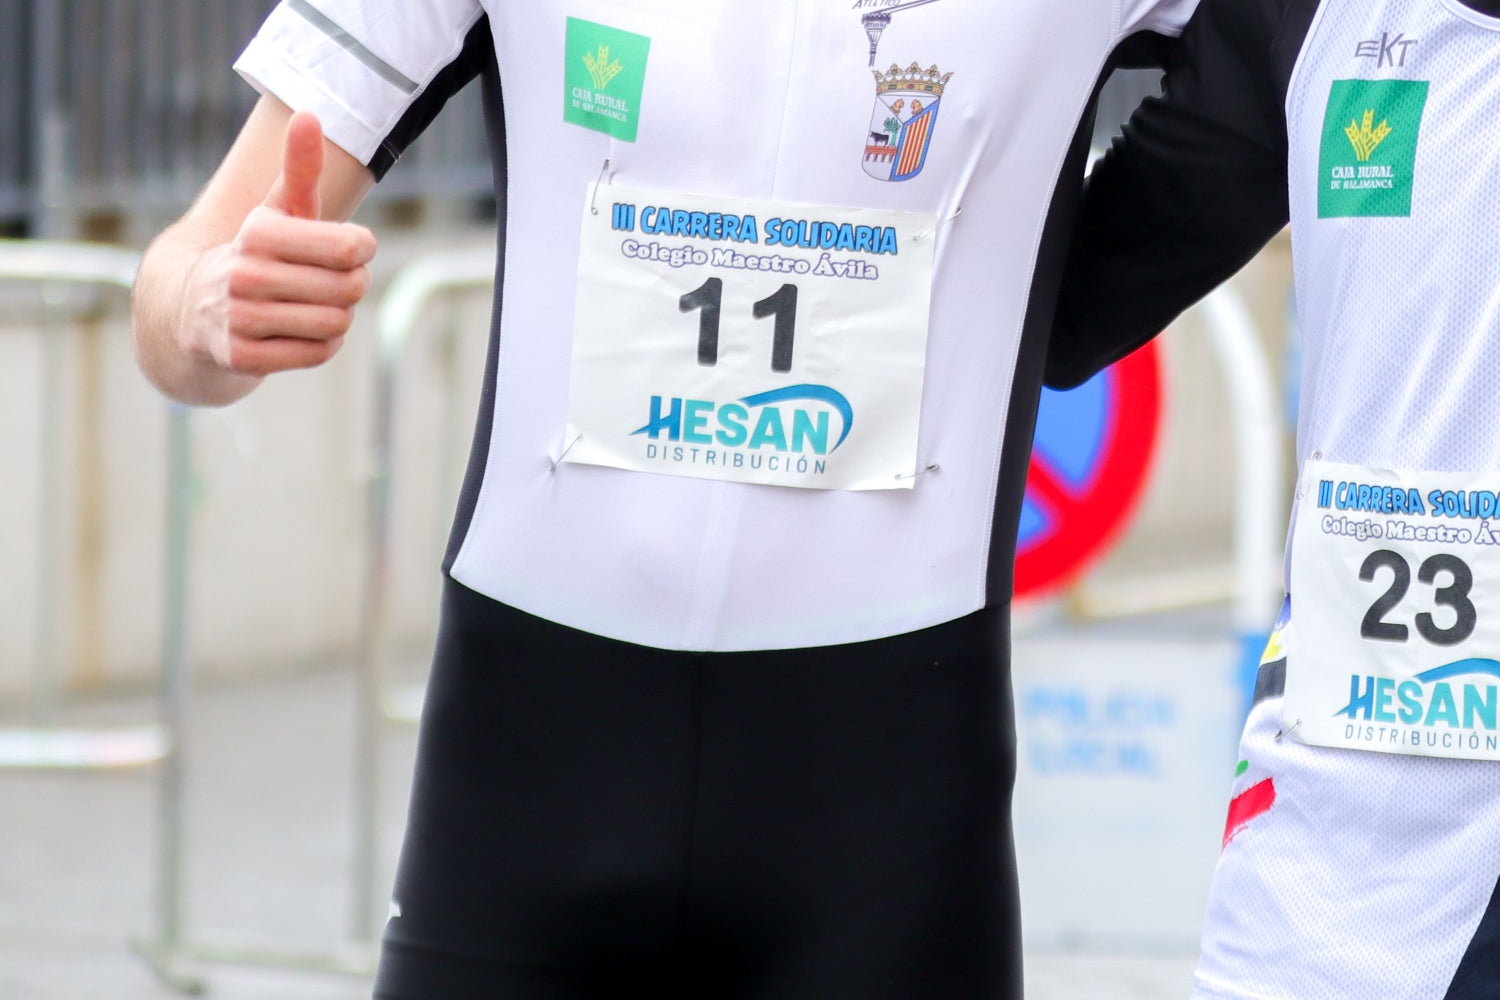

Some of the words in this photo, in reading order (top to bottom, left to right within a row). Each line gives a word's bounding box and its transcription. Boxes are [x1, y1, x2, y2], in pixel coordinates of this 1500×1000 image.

[594, 93, 629, 112] RURAL
[1330, 180, 1341, 189] DE
[1343, 179, 1393, 189] SALAMANCA
[1331, 166, 1355, 179] CAJA
[1357, 165, 1394, 178] RURAL
[612, 203, 635, 231] III
[640, 206, 758, 243] CARRERA
[764, 218, 898, 255] SOLIDARIA
[621, 240, 708, 268] Colegio
[712, 249, 810, 275] Maestro
[813, 254, 878, 280] Ávila
[679, 277, 798, 374] 11
[633, 395, 830, 456] HESAN
[647, 444, 826, 474] DISTRIBUCIÓN
[1317, 480, 1333, 508] III
[1336, 482, 1425, 515] CARRERA
[1321, 515, 1383, 541] Colegio
[1386, 521, 1472, 544] Maestro
[1358, 549, 1477, 647] 23
[1335, 675, 1498, 730] HESAN
[1345, 725, 1498, 750] DISTRIBUCIÓN
